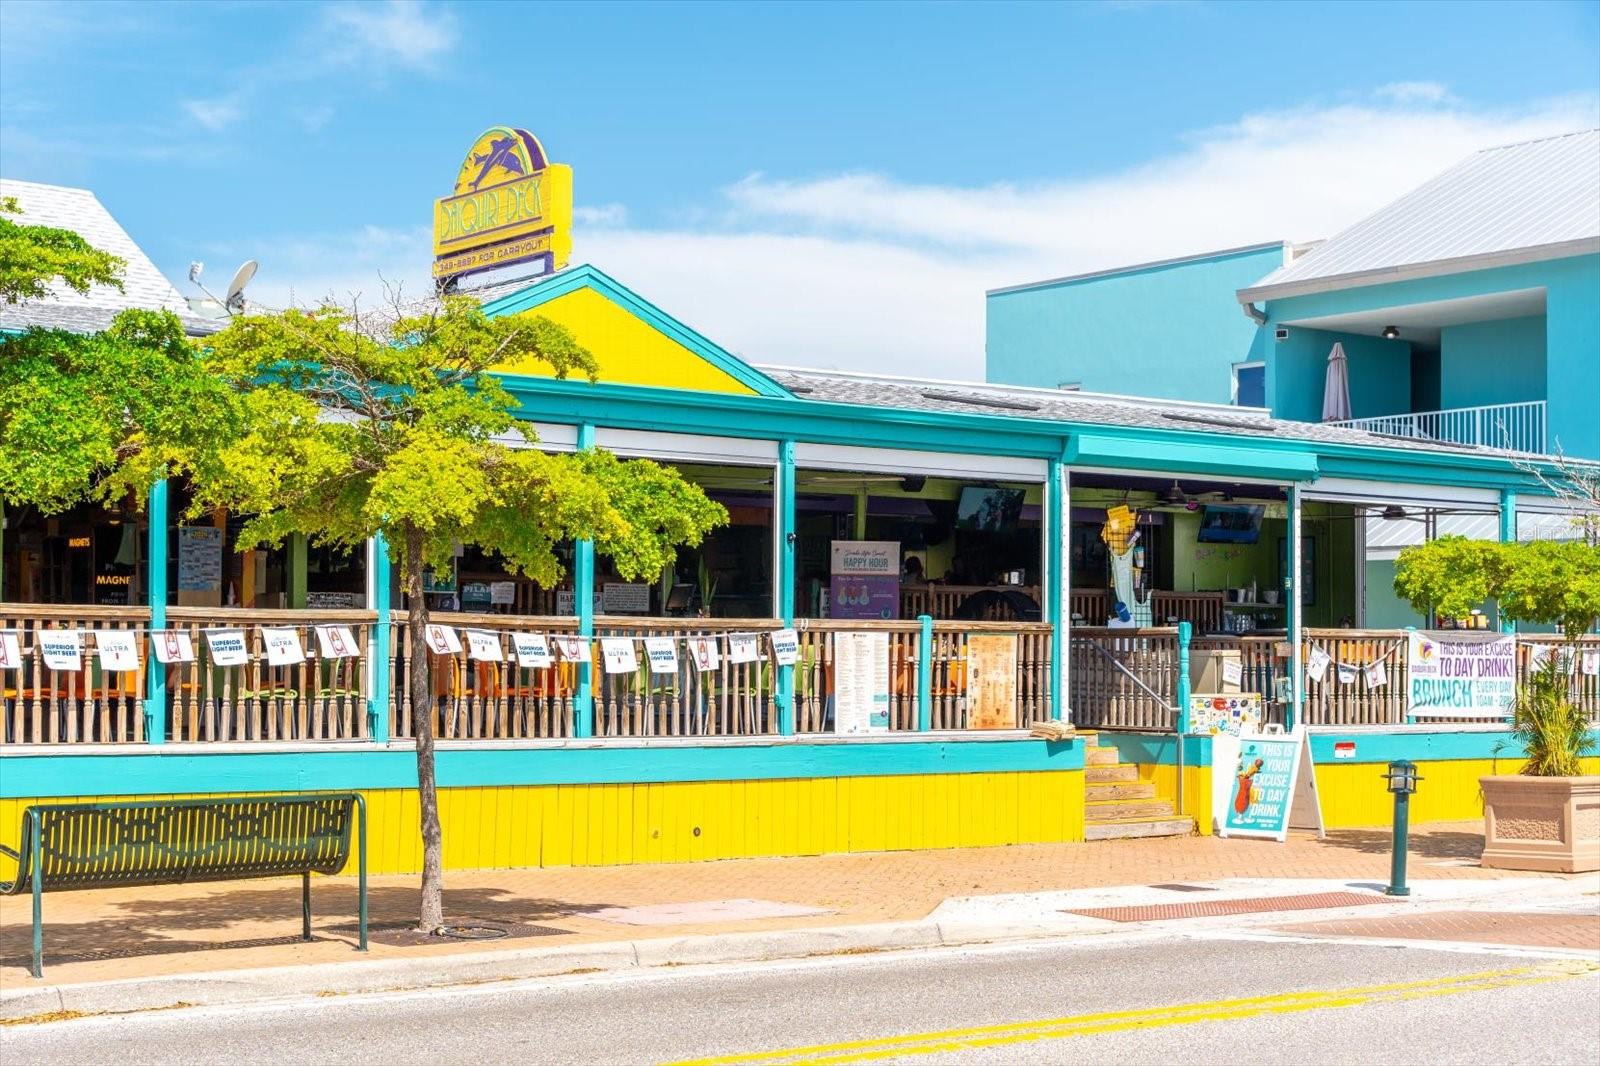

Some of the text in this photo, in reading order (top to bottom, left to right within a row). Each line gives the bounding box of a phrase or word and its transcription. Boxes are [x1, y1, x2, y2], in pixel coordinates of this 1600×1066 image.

[507, 179, 543, 222] DECK
[479, 251, 495, 263] FOR
[498, 239, 543, 258] CARRYOUT
[843, 557, 889, 568] HAPPY HOUR
[1440, 642, 1512, 656] THIS IS YOUR EXCUSE
[1440, 657, 1513, 677] TO DAY DRINK!
[1412, 679, 1473, 708] BRUNCH
[1476, 681, 1512, 693] EVERY DAY
[1476, 695, 1493, 706] 10AM
[1263, 744, 1293, 757] THIS IS
[1268, 759, 1290, 771] YOUR
[1253, 774, 1289, 787] EXCUSE
[1253, 788, 1286, 801] TO DAY
